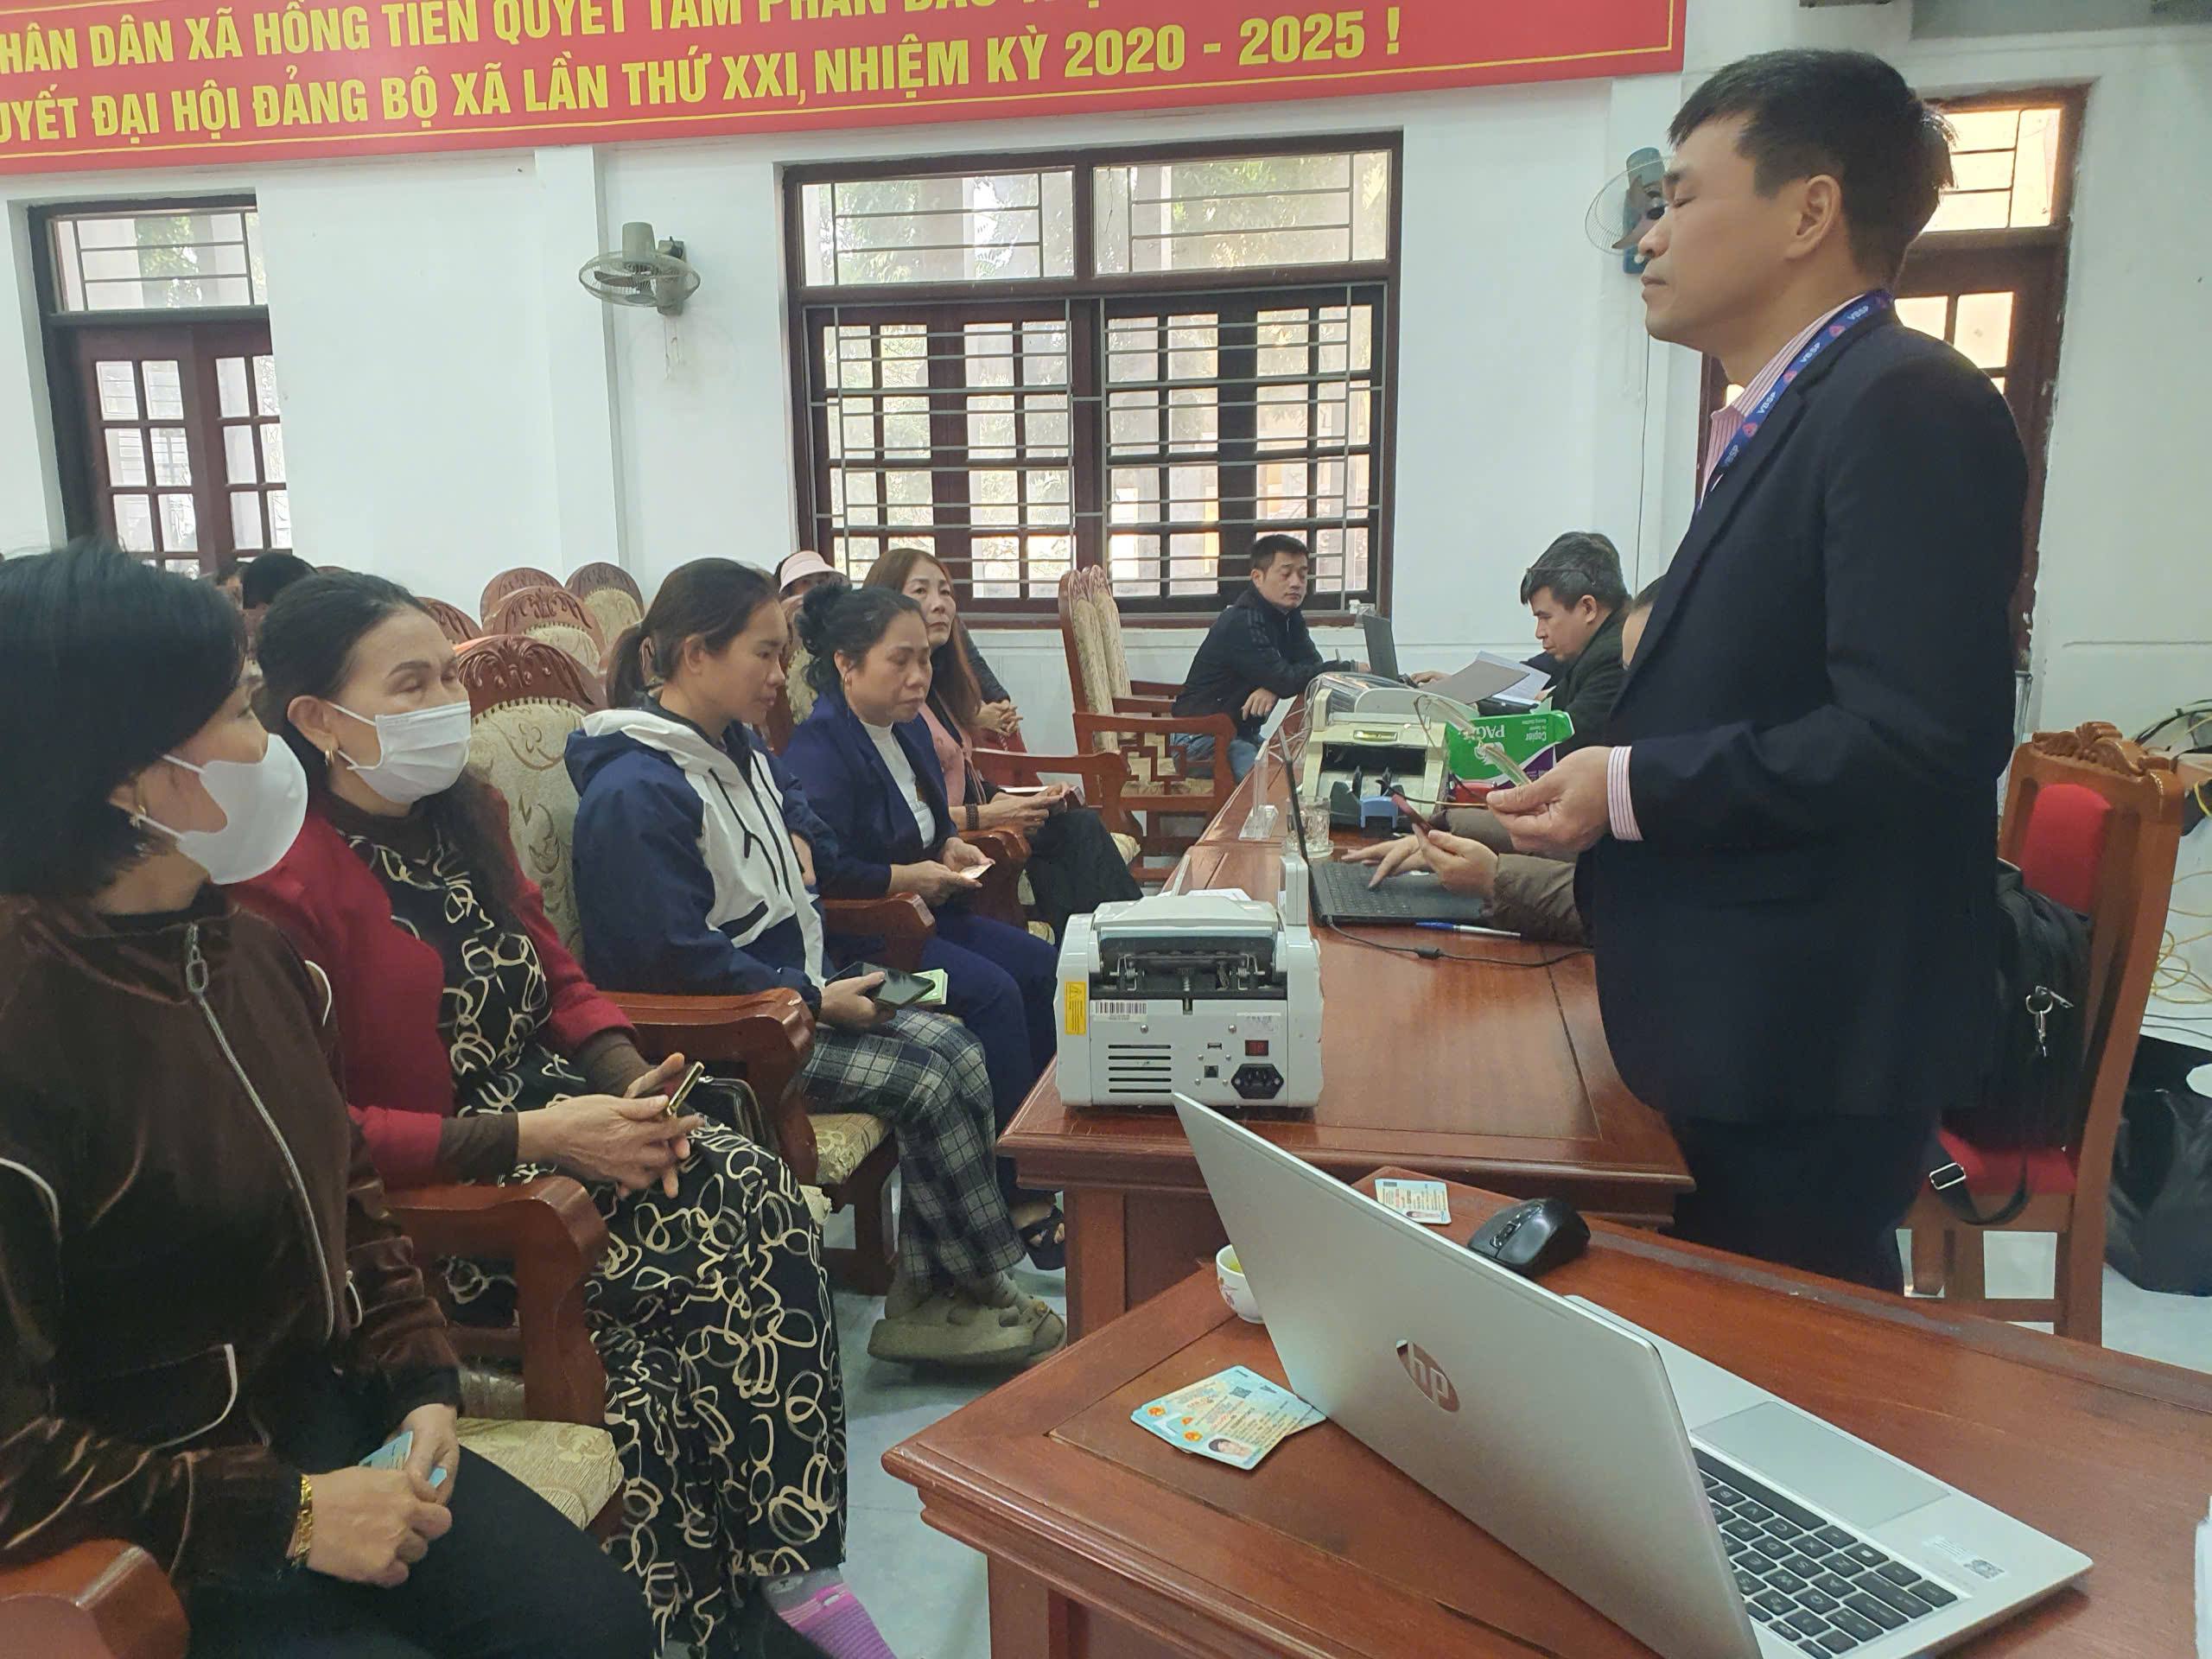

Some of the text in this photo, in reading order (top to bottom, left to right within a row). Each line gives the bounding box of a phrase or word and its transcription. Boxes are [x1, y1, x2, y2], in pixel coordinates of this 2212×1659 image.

[89, 15, 174, 67] DÂN
[185, 7, 243, 60] XÃ
[92, 92, 160, 144] ĐẠI
[171, 79, 241, 139] HỘI
[252, 65, 368, 127] ĐẢNG
[381, 66, 438, 127] BỘ
[450, 62, 512, 116] XÃ
[523, 51, 608, 111] LẦN
[621, 45, 712, 105] THỨ
[721, 52, 806, 105] XXI,
[814, 34, 969, 99] NHIỆM
[987, 24, 1048, 83] KỲ
[1065, 24, 1185, 78] 2020
[1203, 42, 1221, 54] -
[1239, 10, 1364, 66] 2025
[1387, 7, 1400, 55] !
[1847, 306, 1869, 321] VBSP
[1800, 342, 1821, 363] VBSP
[1757, 391, 1777, 414] VBSP
[1723, 444, 1739, 466] BSP
[1402, 1339, 1453, 1412] hp
